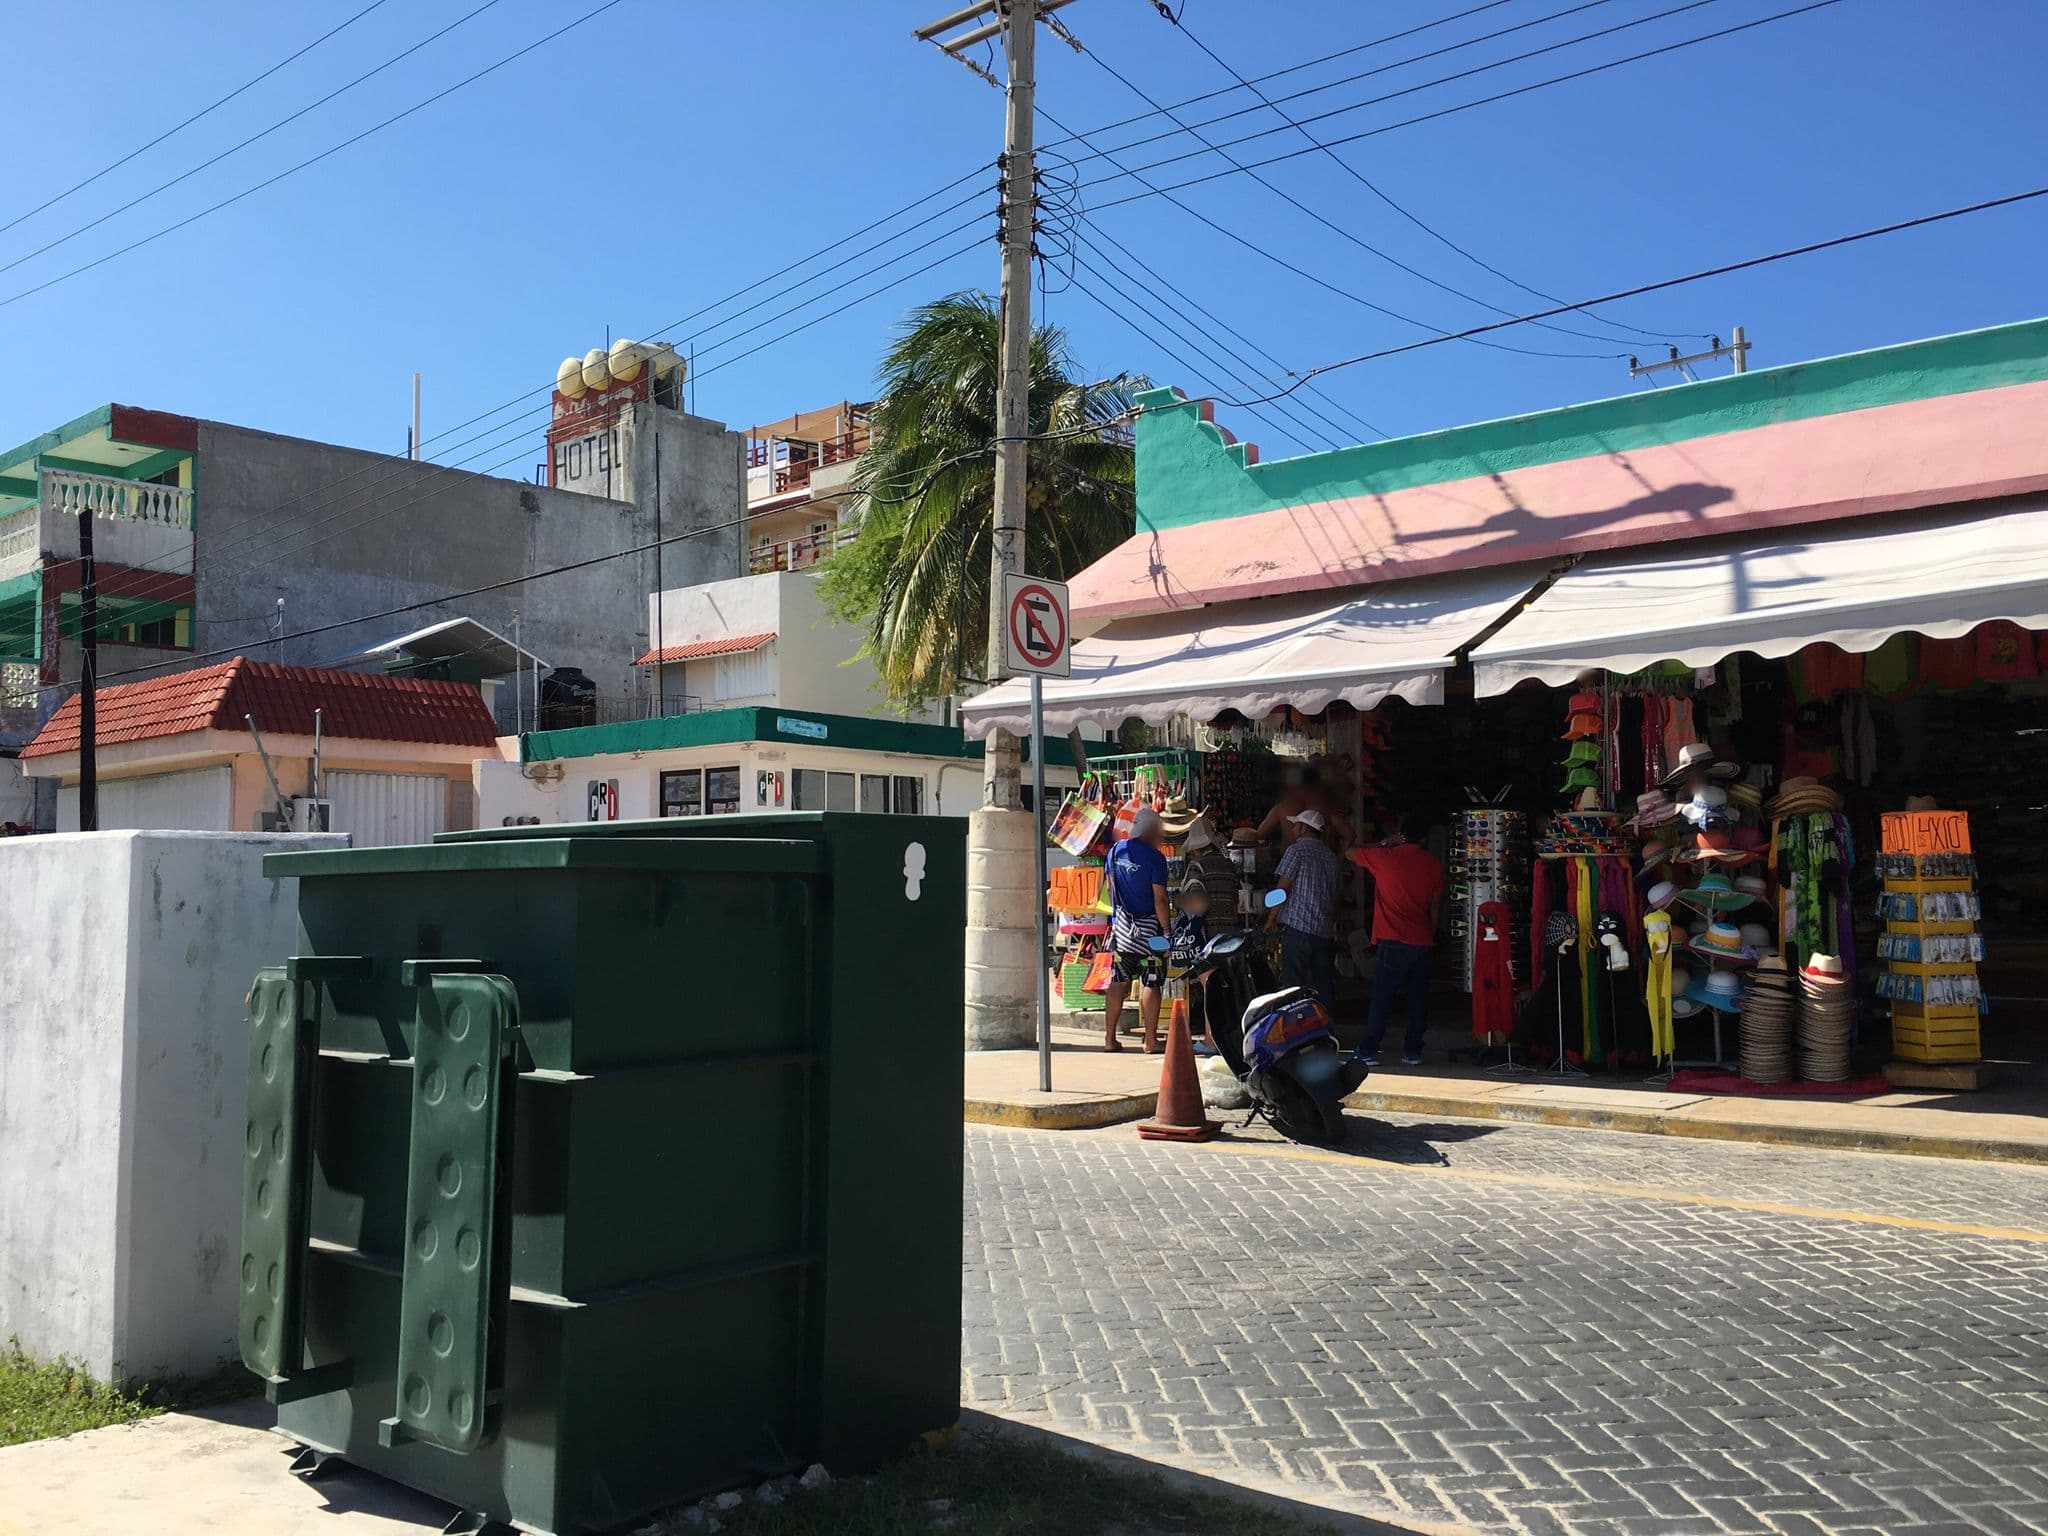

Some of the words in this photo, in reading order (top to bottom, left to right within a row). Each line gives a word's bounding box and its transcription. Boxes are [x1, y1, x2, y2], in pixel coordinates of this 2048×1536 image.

[554, 430, 622, 485] HOTEL
[591, 782, 615, 818] PRI
[760, 772, 781, 796] PRI
